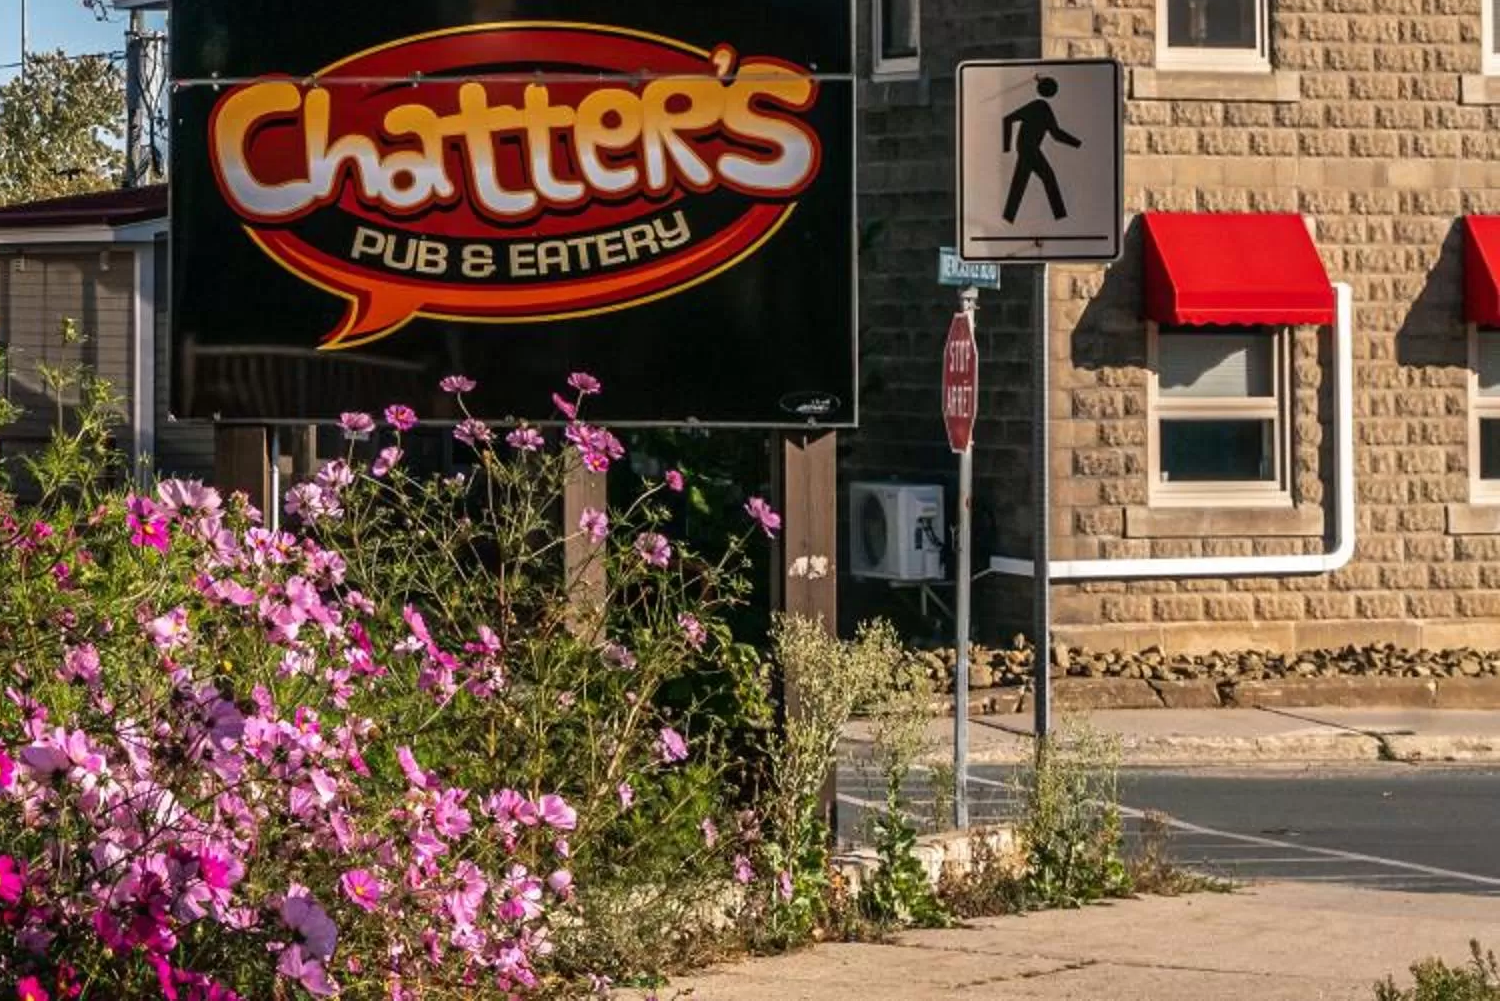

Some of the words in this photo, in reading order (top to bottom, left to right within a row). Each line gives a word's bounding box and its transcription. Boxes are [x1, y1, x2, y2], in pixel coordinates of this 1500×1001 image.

[351, 226, 448, 275] PUB
[461, 245, 497, 278] &
[509, 210, 692, 277] EATERY
[949, 340, 971, 373] STOP
